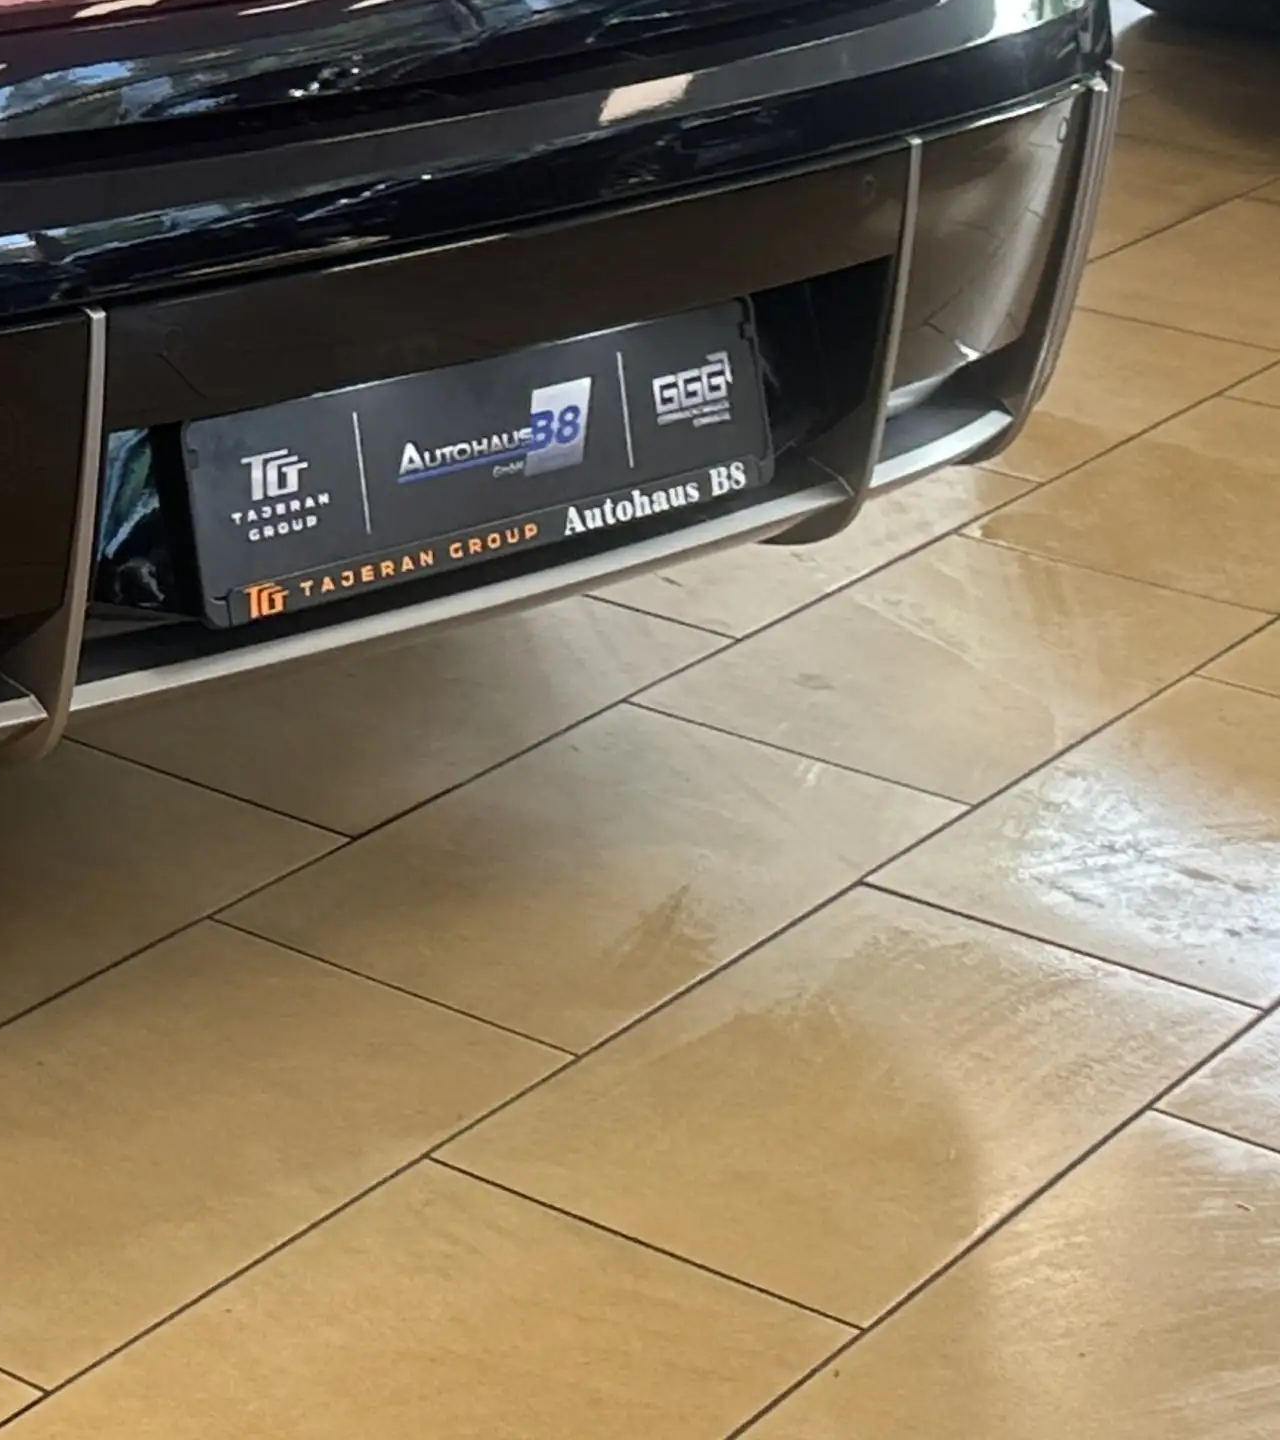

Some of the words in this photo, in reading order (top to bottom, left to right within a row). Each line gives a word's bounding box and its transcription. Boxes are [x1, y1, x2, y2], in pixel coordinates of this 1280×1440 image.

[230, 491, 331, 526] TAJERAN
[248, 514, 319, 542] GROUP
[563, 481, 700, 536] Autohaus
[299, 549, 436, 597] TAJERAN
[448, 522, 540, 561] GROUP
